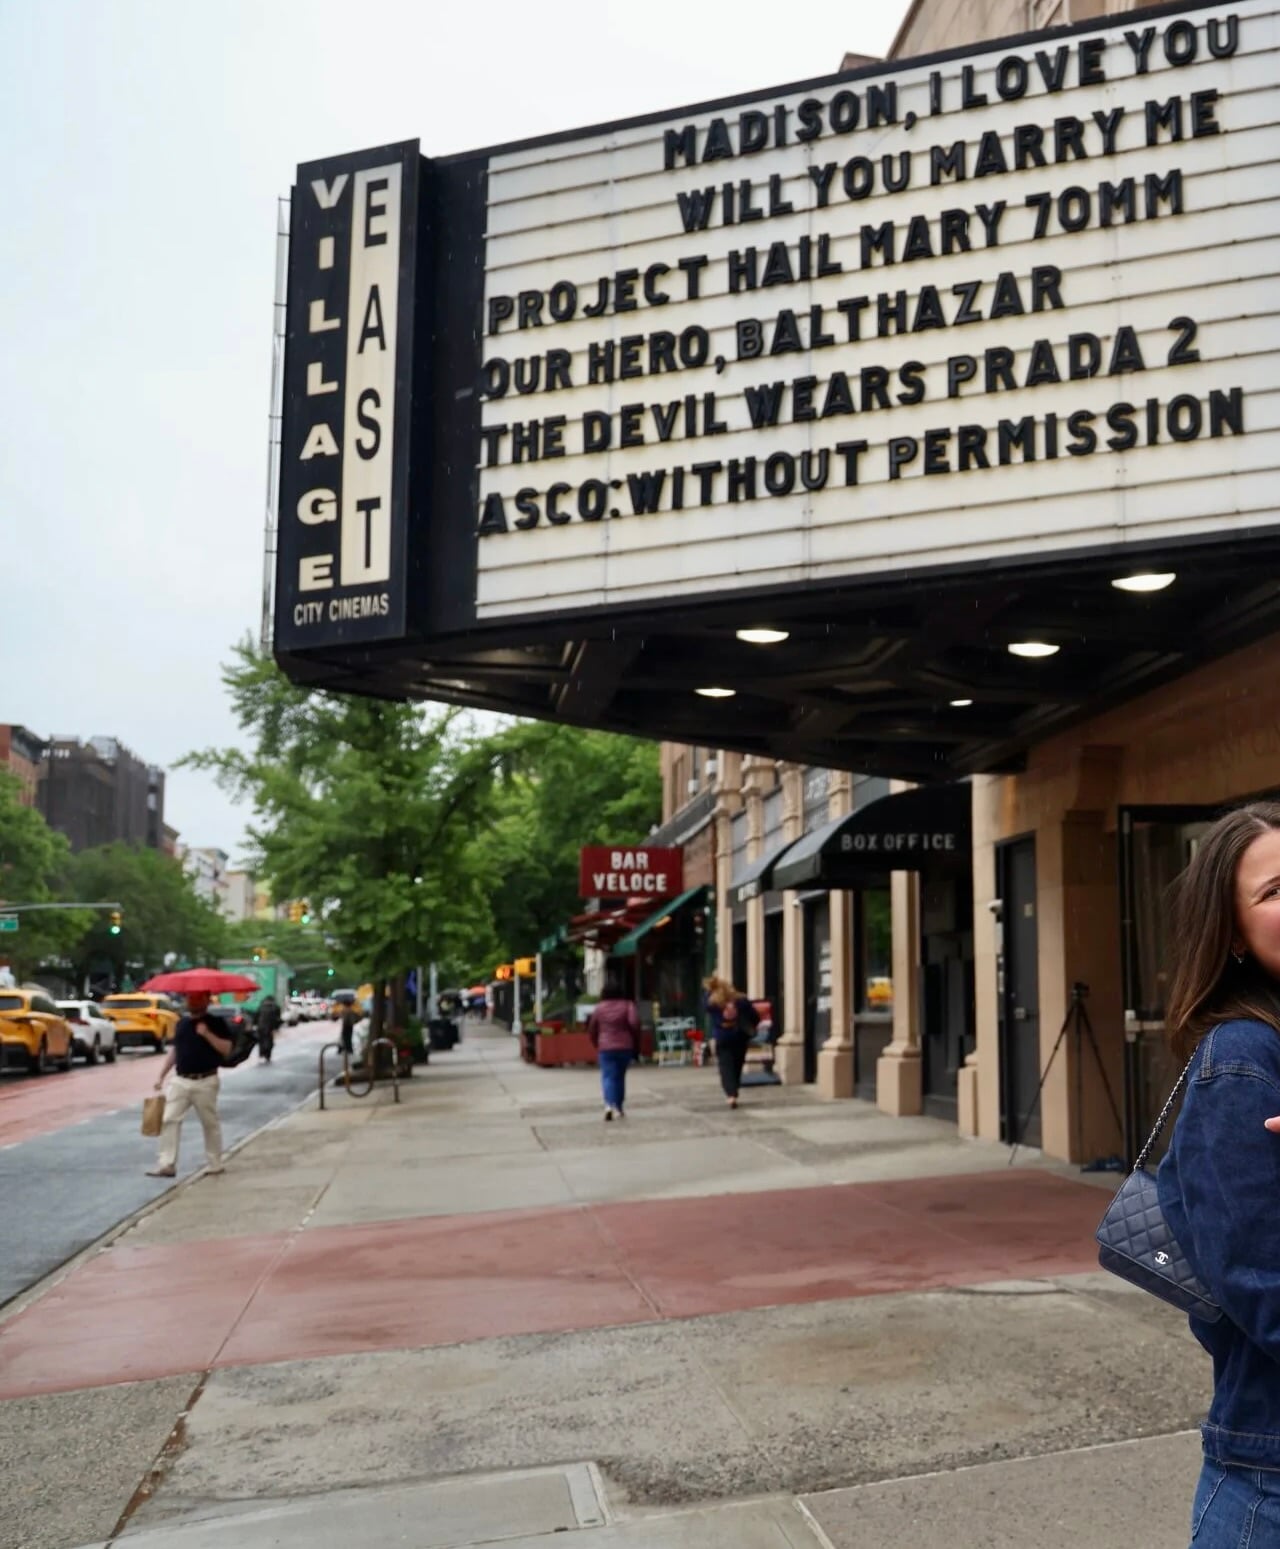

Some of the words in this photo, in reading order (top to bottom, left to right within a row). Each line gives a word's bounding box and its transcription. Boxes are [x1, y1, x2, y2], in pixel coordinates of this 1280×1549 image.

[664, 81, 917, 170] MADISON,
[930, 71, 943, 117] I
[962, 38, 1106, 109] LOVE
[1123, 14, 1239, 75] YOU
[677, 173, 793, 233] WILL
[808, 150, 911, 208] YOU
[930, 107, 1124, 186] MARRY
[1145, 88, 1221, 147] ME
[488, 255, 708, 335] PROJECT
[729, 233, 842, 294] HAIL
[860, 200, 1007, 269] MARY
[1026, 169, 1183, 238] 70MM
[297, 174, 349, 592] VILLAGE
[355, 178, 389, 569] EAST
[480, 415, 568, 467] THE
[583, 392, 728, 453] DEVIL
[744, 361, 927, 429] WEARS
[948, 326, 1146, 398] PRADA
[1168, 316, 1200, 366] 2
[482, 349, 573, 399] OUR
[588, 325, 726, 383] HERO,
[736, 265, 1065, 361] BALTHAZAR
[889, 387, 1243, 480] PERMISSION
[294, 602, 324, 626] CITY
[329, 593, 389, 621] CINEMAS
[593, 872, 667, 892] VELOCE
[611, 851, 649, 870] BAR
[841, 834, 877, 850] BOX
[884, 833, 955, 850] OFFICE
